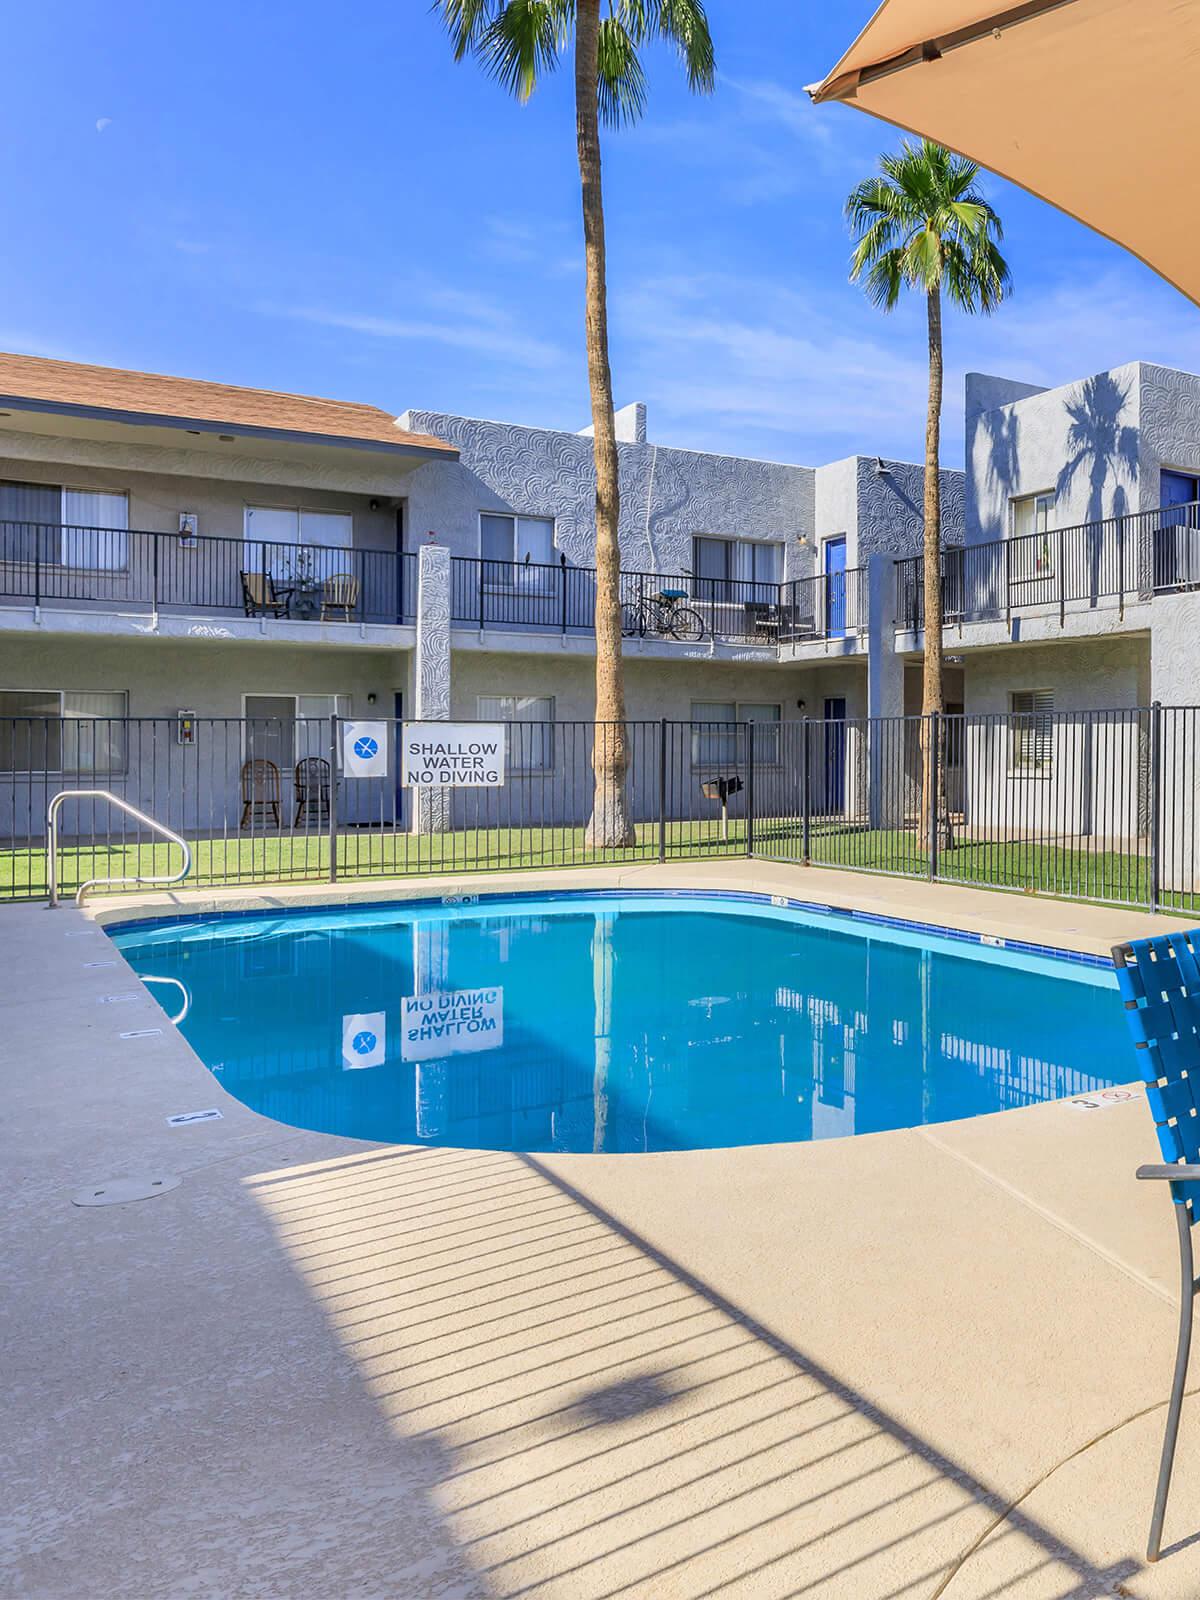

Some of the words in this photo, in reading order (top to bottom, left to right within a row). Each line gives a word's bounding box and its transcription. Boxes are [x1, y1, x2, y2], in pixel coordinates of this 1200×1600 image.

[409, 743, 498, 756] SHALLOW
[423, 757, 484, 769] WATER
[408, 771, 434, 783] NO
[439, 770, 498, 783] DIVING
